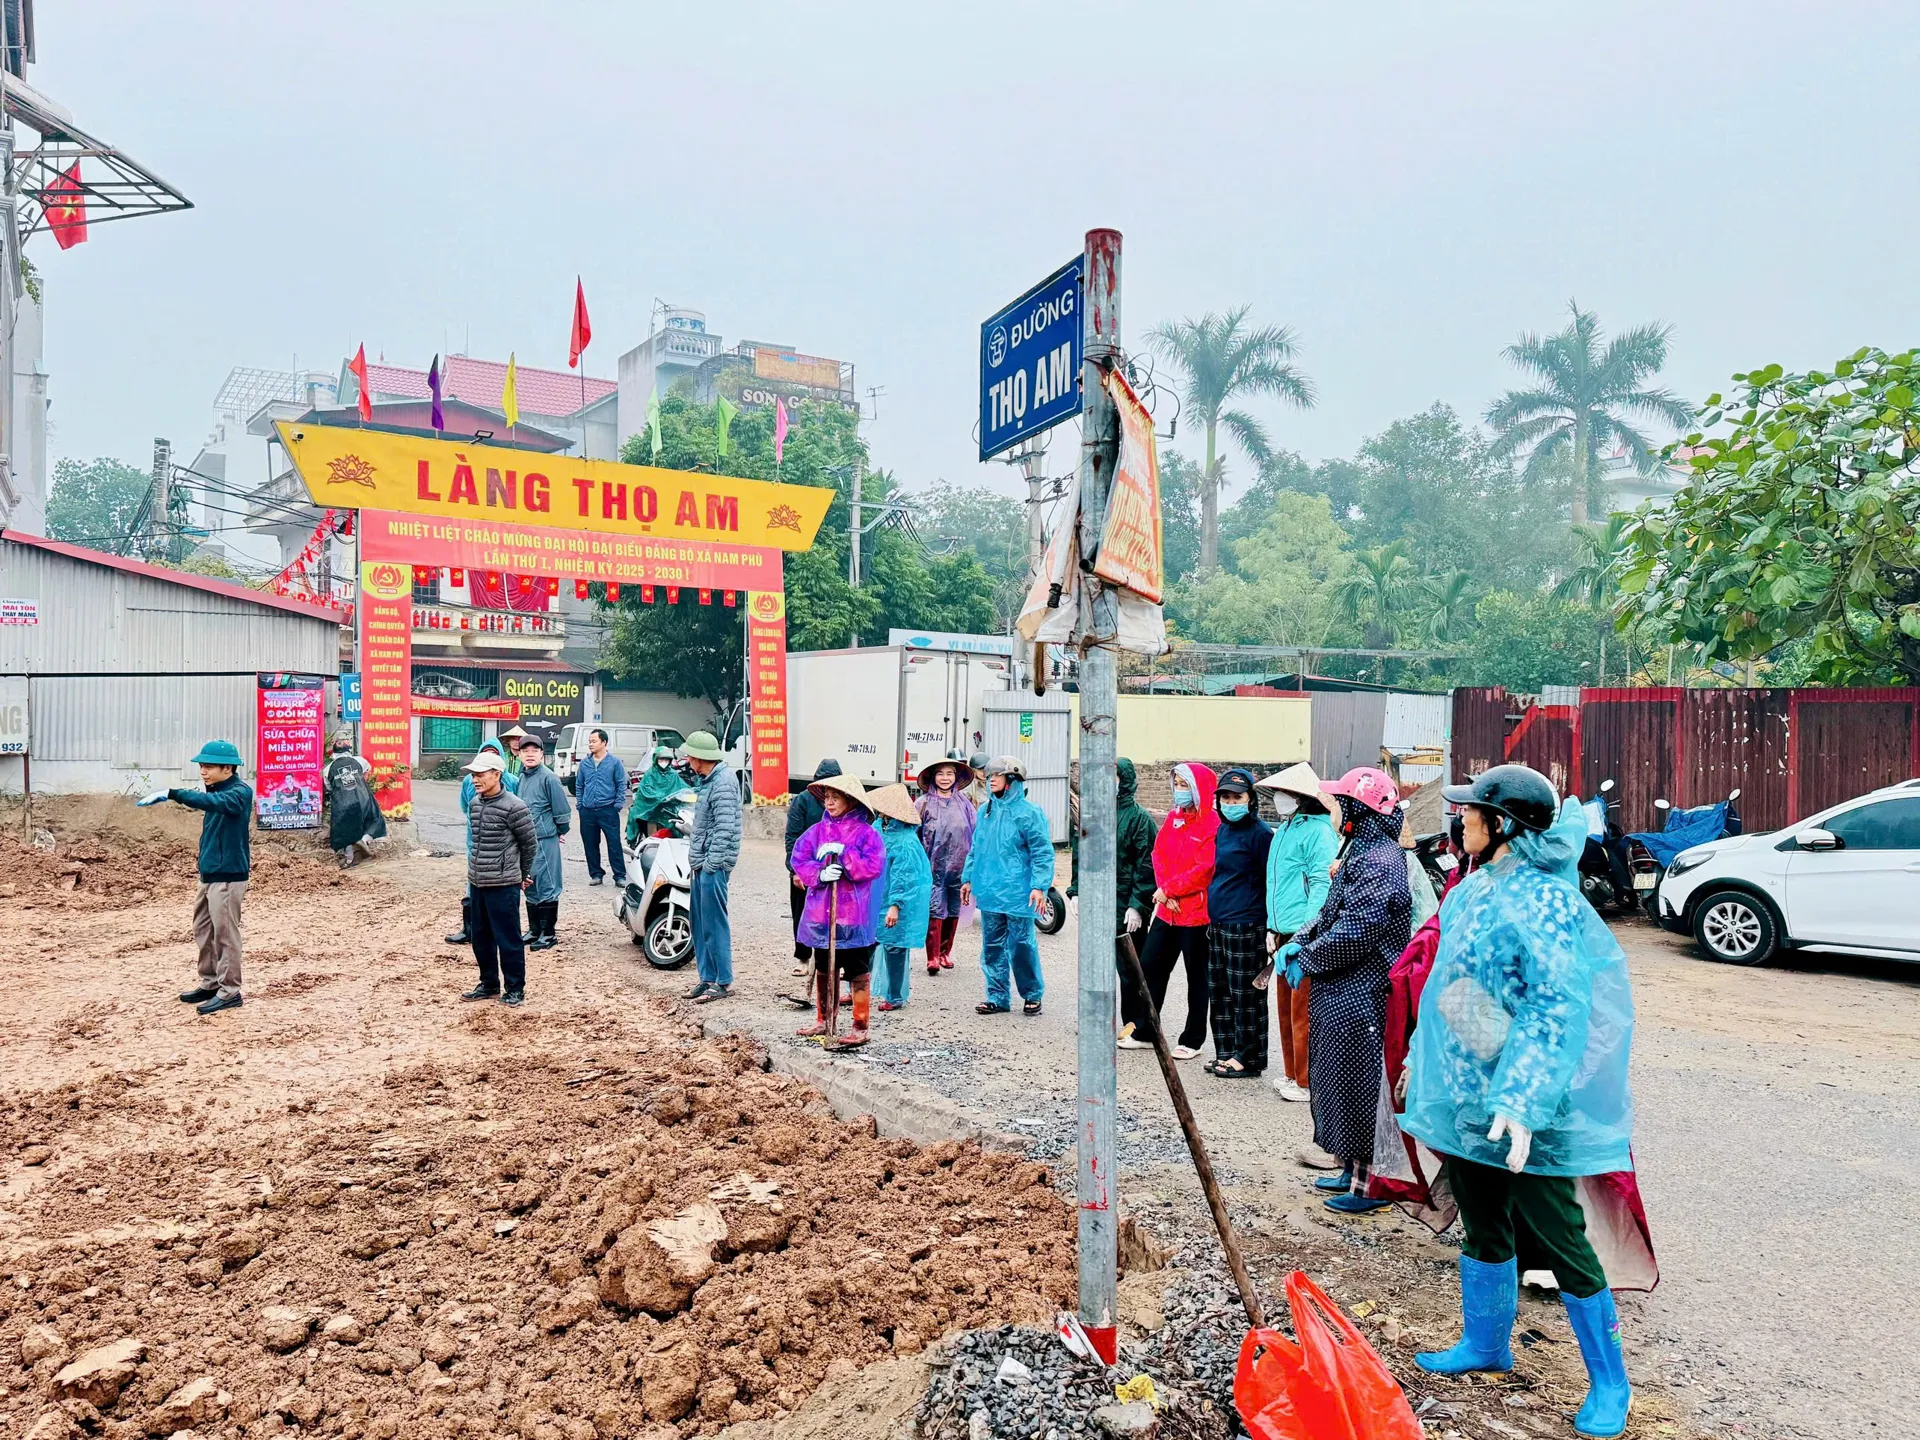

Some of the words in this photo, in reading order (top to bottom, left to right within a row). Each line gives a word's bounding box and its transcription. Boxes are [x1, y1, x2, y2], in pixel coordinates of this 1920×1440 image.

[1011, 289, 1074, 349] ĐƯỜNG
[988, 368, 1027, 429] THỌ
[1033, 340, 1071, 410] AM
[417, 453, 550, 513] LÀNG
[572, 478, 658, 531] THỌ
[674, 490, 739, 531] AM
[388, 520, 429, 540] NHIỆT
[433, 524, 461, 543] LIỆT
[464, 526, 500, 544] CHÀO
[503, 531, 541, 549] MỪNG
[544, 536, 566, 553] ĐẠI
[568, 537, 590, 556] HỘI
[592, 540, 613, 558] ĐẠI
[615, 540, 643, 558] BIỂU
[645, 544, 676, 560] ĐẢNG
[679, 546, 696, 564] BỘ
[697, 549, 712, 563] XÃ
[714, 552, 739, 565] NAM
[741, 552, 763, 566] PHÙ
[483, 549, 510, 566] LẦN
[512, 552, 538, 568] THỨ
[554, 558, 595, 574] NHIỆM
[598, 559, 613, 575] KỲ
[616, 564, 645, 578] 2025
[655, 567, 683, 580] 2030
[505, 678, 543, 697] Quán
[546, 680, 580, 698] Cafe
[264, 700, 288, 708] MUA
[544, 704, 571, 717] CITY
[264, 728, 286, 739] SỬA
[287, 727, 316, 738] CHỮA
[2, 742, 23, 752] 932
[268, 740, 294, 752] MIỄN
[295, 740, 312, 751] PHÍ
